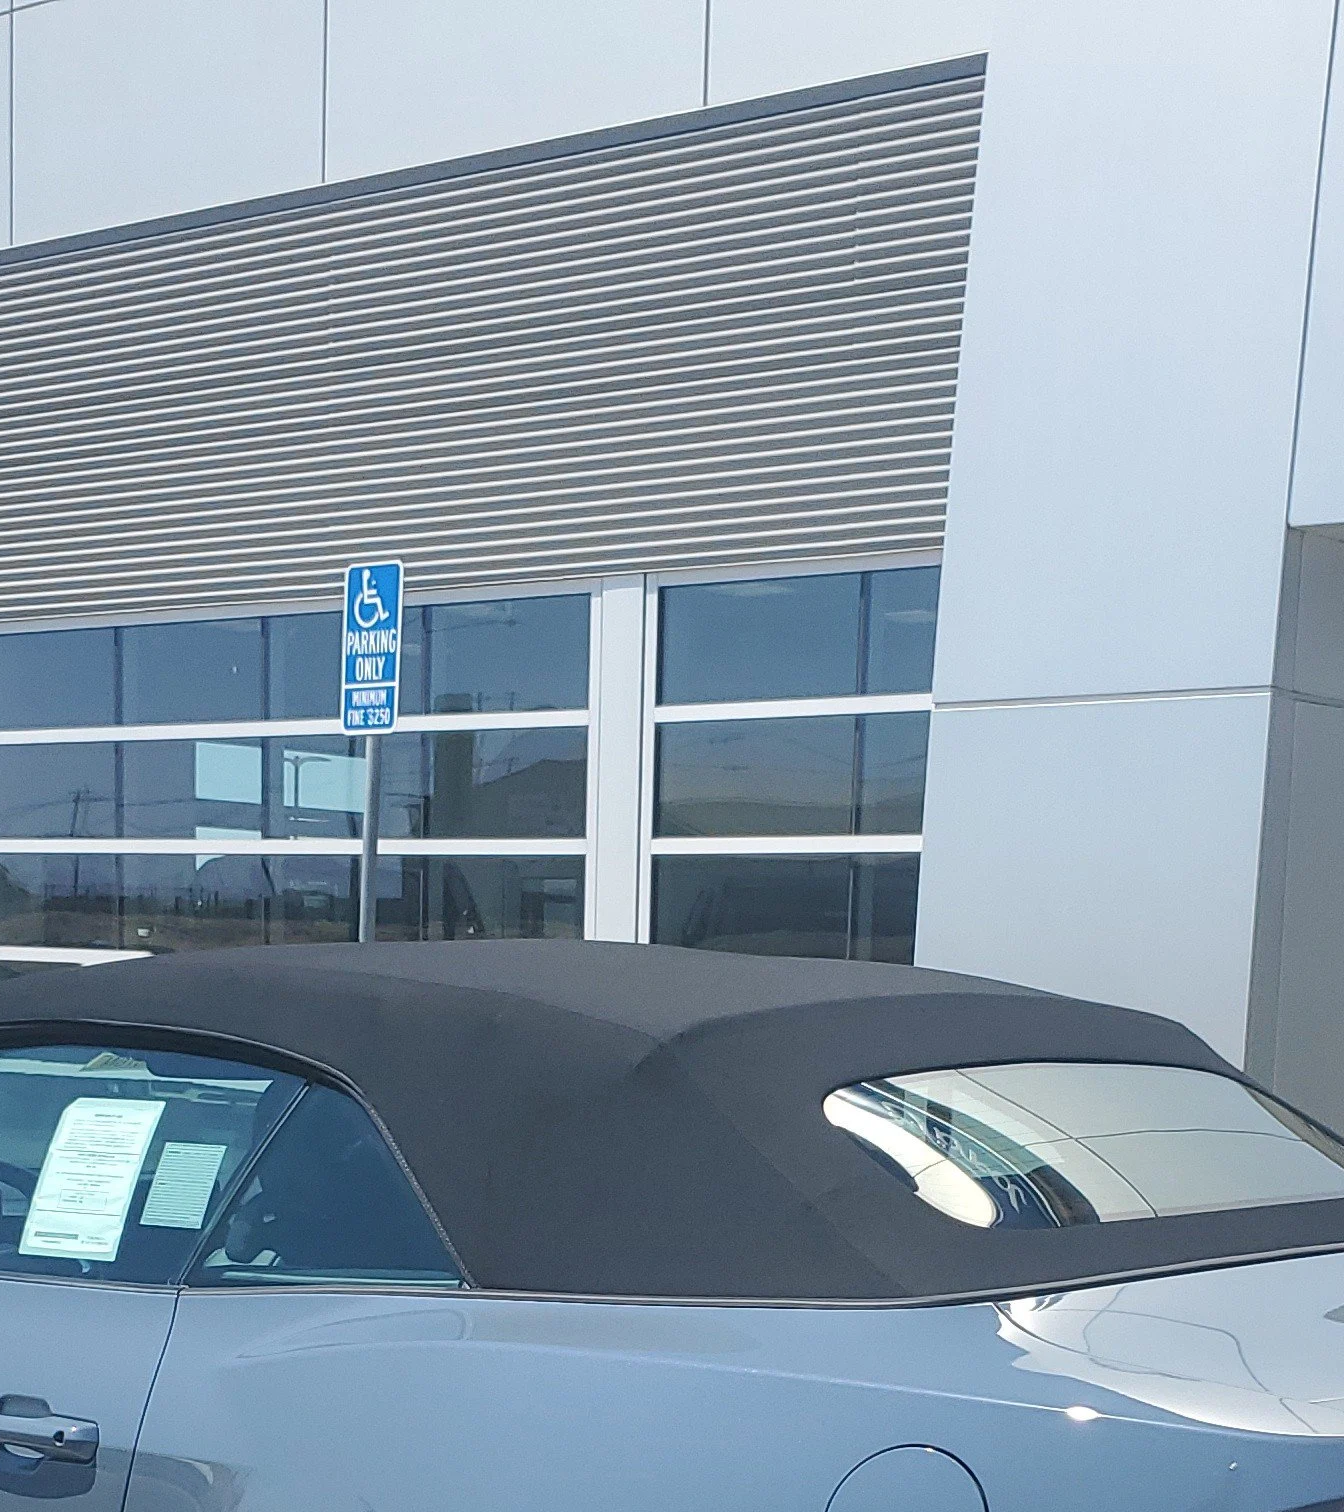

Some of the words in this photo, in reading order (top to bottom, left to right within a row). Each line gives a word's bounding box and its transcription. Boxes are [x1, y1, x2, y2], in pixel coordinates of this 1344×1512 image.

[346, 629, 397, 655] PARKING
[355, 656, 385, 681] ONLY
[351, 689, 387, 708] MINIMUM
[347, 709, 365, 726] FINE
[367, 707, 391, 726] $250
